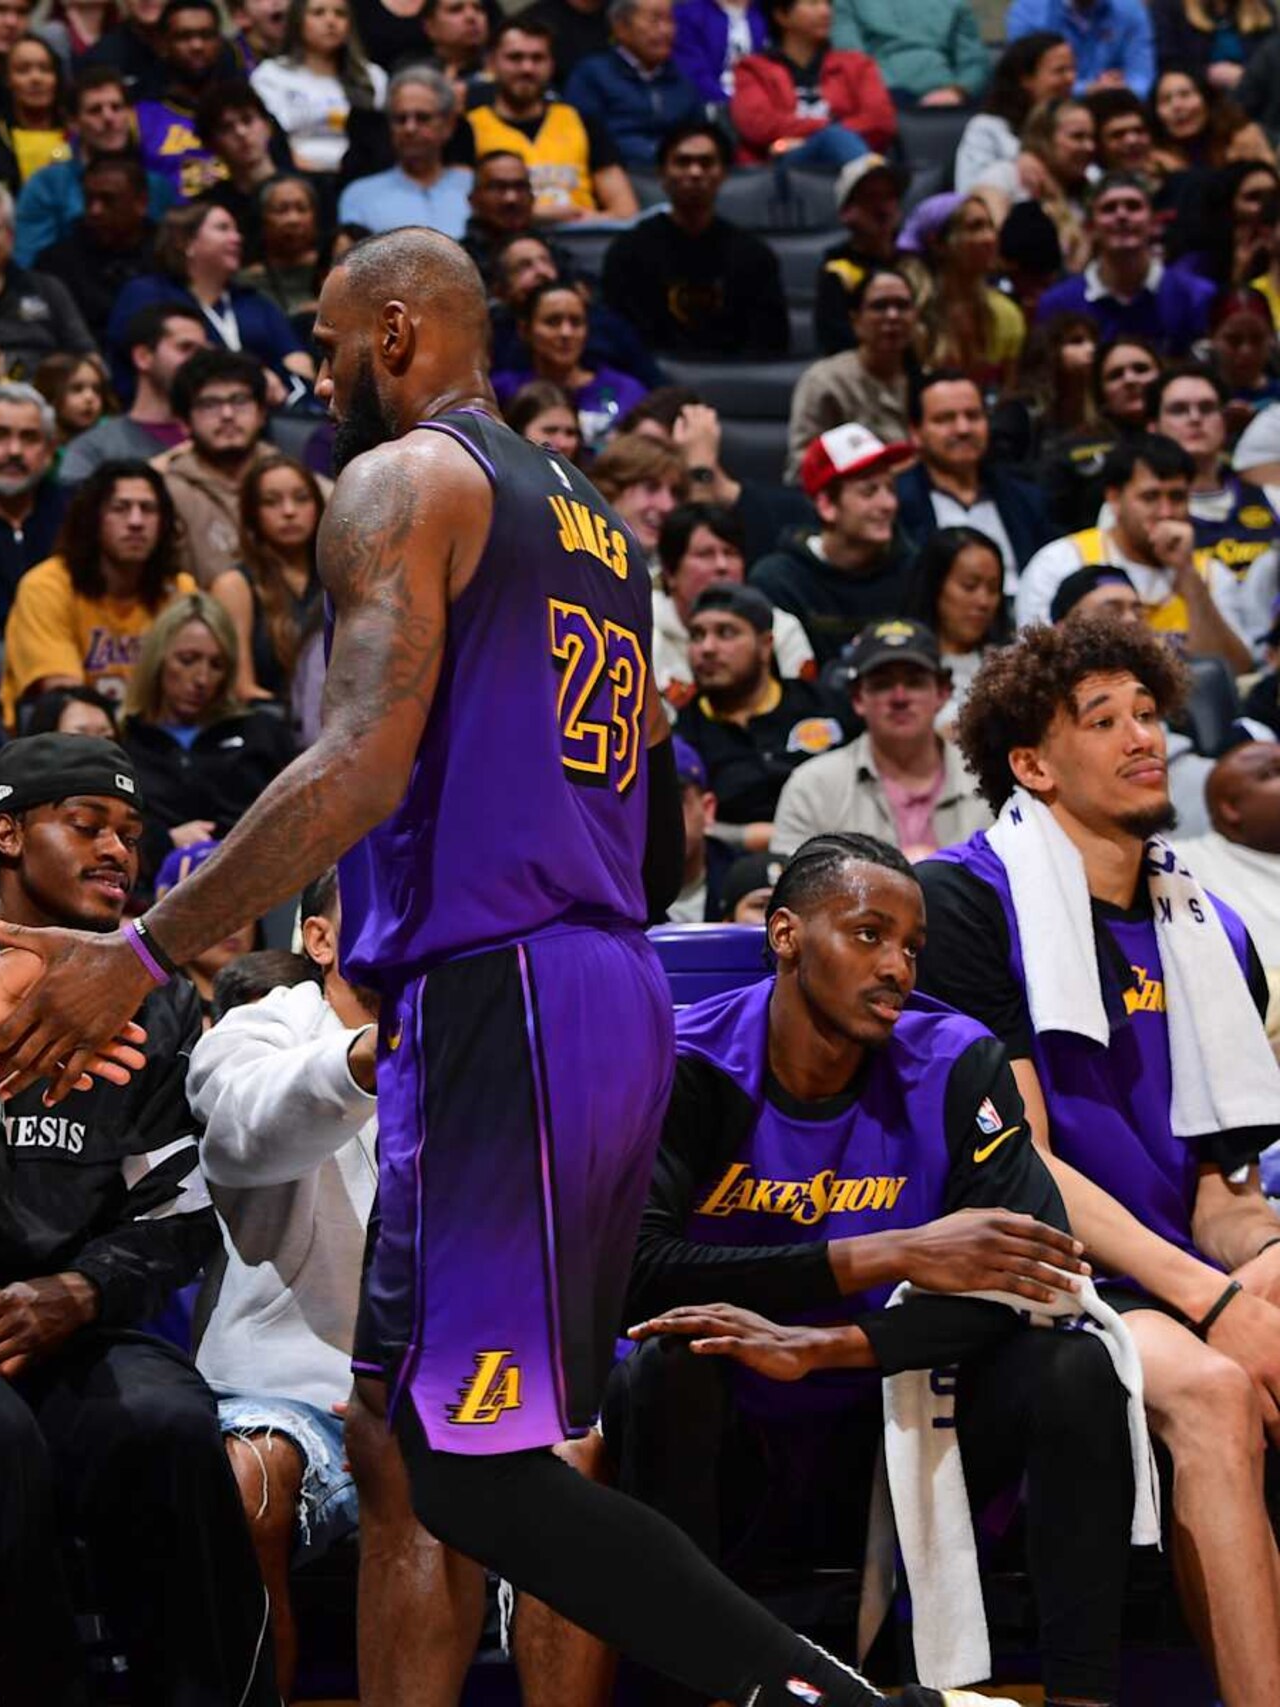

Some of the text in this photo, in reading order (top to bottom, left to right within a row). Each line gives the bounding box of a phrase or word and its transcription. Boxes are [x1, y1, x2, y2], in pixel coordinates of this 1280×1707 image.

[548, 494, 628, 579] JAMES
[548, 597, 648, 793] 23
[446, 1349, 522, 1424] LA
